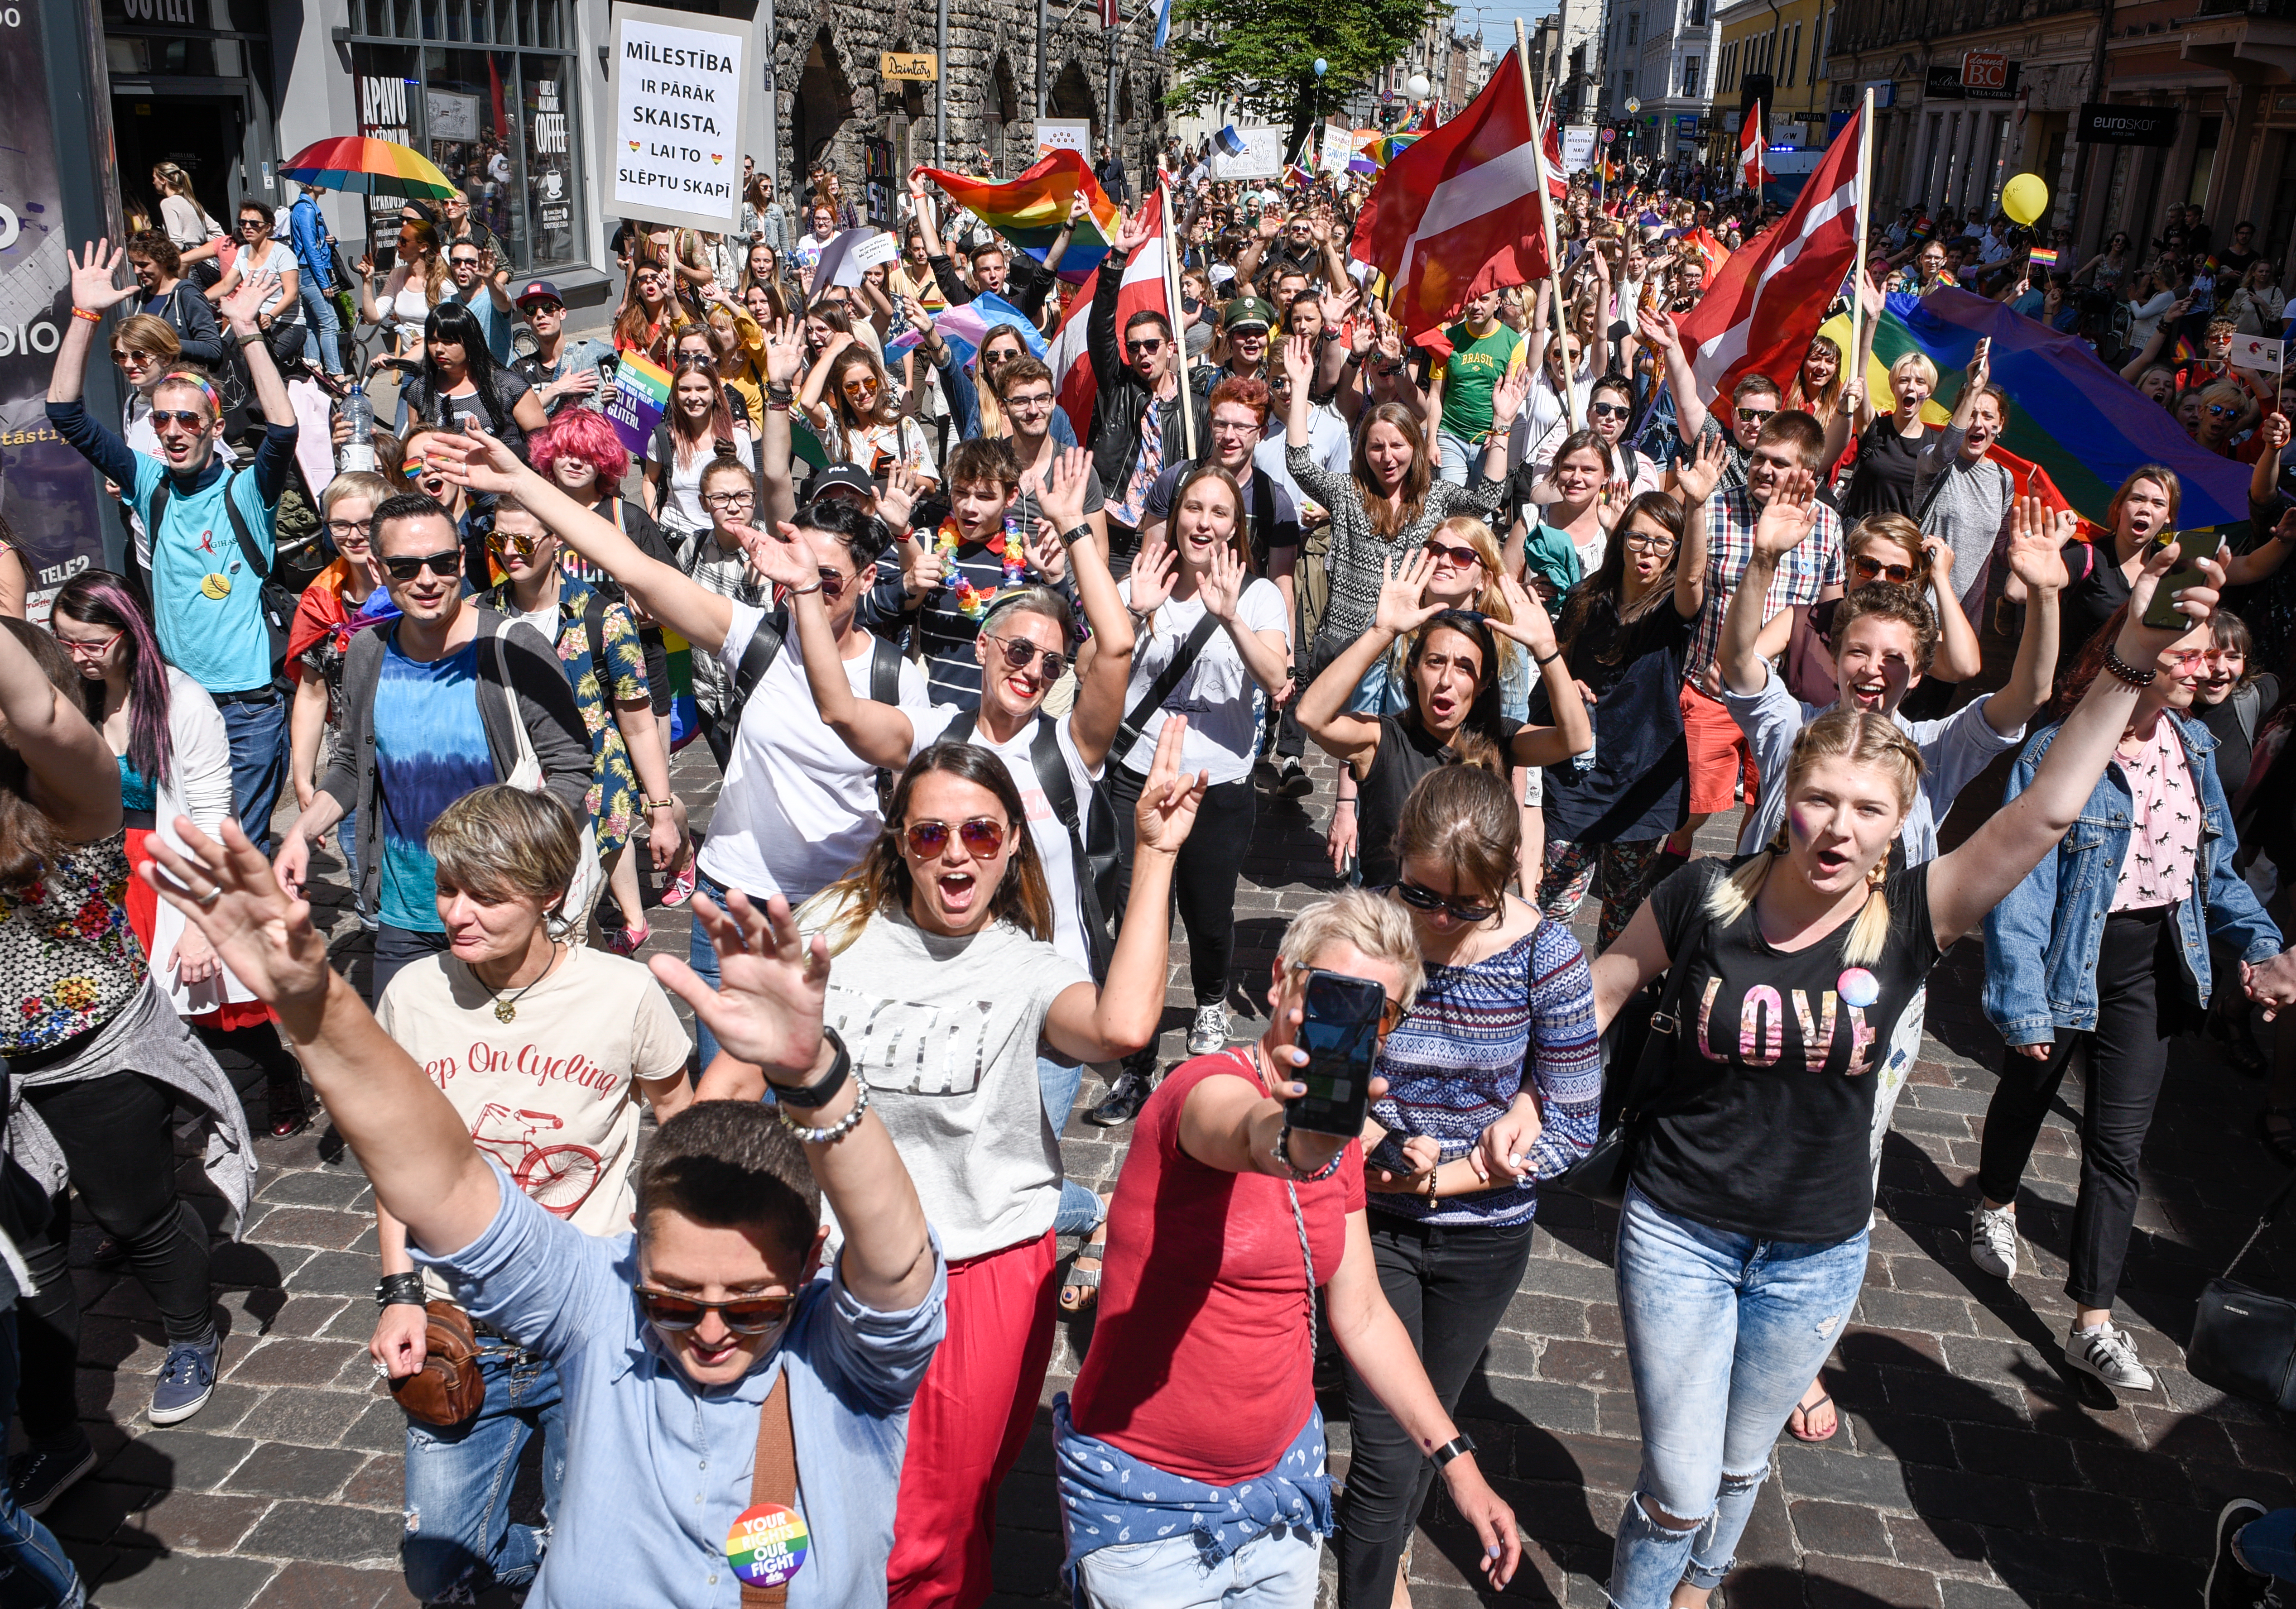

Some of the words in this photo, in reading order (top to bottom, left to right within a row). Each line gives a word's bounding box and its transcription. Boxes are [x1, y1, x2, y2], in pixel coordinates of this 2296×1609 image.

[0, 8, 21, 28] O
[626, 41, 733, 74] MĪLESTĪBA
[888, 56, 931, 78] Dzintars
[1967, 65, 2002, 86] B.C.
[539, 80, 551, 96] CAKES
[551, 81, 555, 96] &
[642, 78, 656, 94] IR
[661, 81, 716, 103] PĀRĀK
[362, 76, 407, 125] APAVU
[538, 96, 559, 112] MACARONS
[633, 105, 721, 138] SKAISTA,
[535, 113, 566, 153] COFFEE
[651, 143, 675, 159] LAI
[680, 147, 701, 162] TO
[1326, 147, 1347, 162] SAVAS
[619, 169, 678, 190] SLĒPTU
[683, 179, 730, 198] SKAPĪ
[1461, 352, 1493, 369] BRASIL
[615, 390, 624, 405] SI
[626, 396, 638, 413] KĀ
[828, 466, 848, 474] FILA
[39, 555, 90, 584] TELE2
[26, 599, 51, 609] Turtle
[1697, 977, 1878, 1077] LOVE
[468, 1041, 513, 1073] On
[518, 1044, 619, 1100] Cycling
[742, 1512, 787, 1534] YOUR
[741, 1524, 794, 1551] RIGHTS
[754, 1542, 789, 1561] OUR
[751, 1552, 795, 1577] FIGHT
